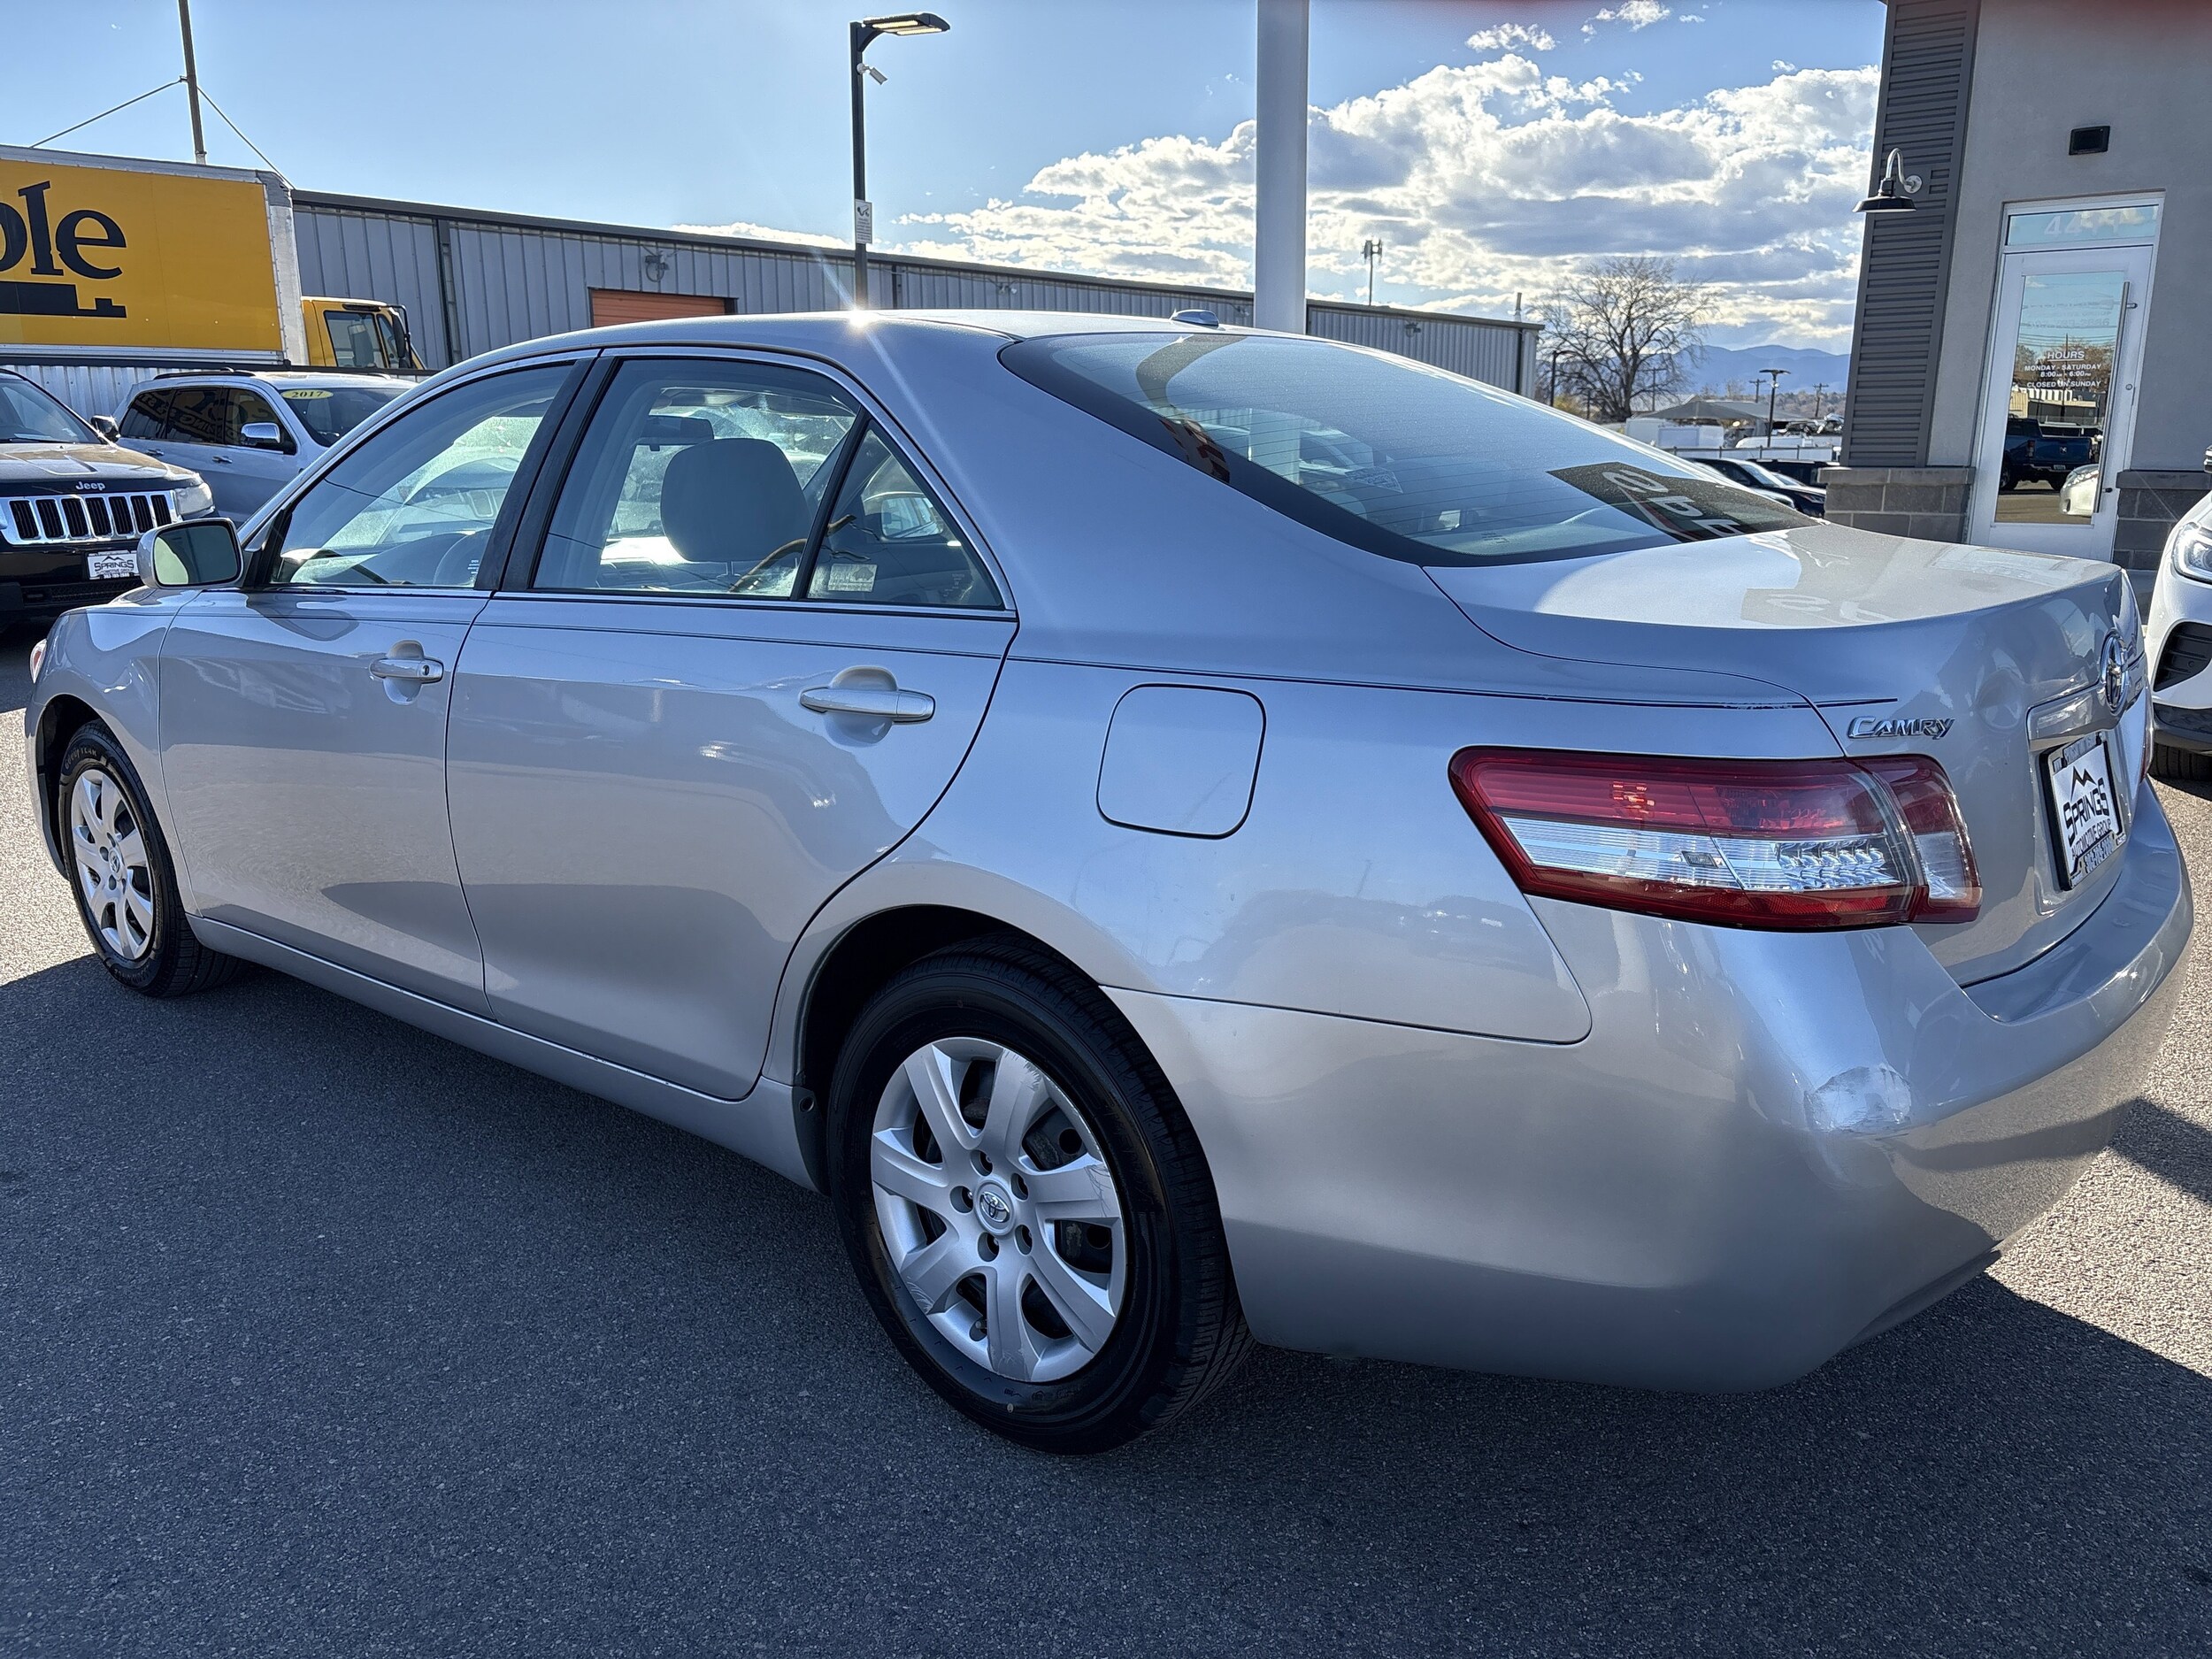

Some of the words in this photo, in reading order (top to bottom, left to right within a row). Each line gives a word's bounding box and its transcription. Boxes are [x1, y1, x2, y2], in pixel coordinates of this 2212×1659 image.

[2047, 350, 2085, 359] HOURS
[75, 481, 105, 491] Jeep
[94, 559, 134, 572] SPRINGS
[2062, 777, 2110, 847] SPRINGS
